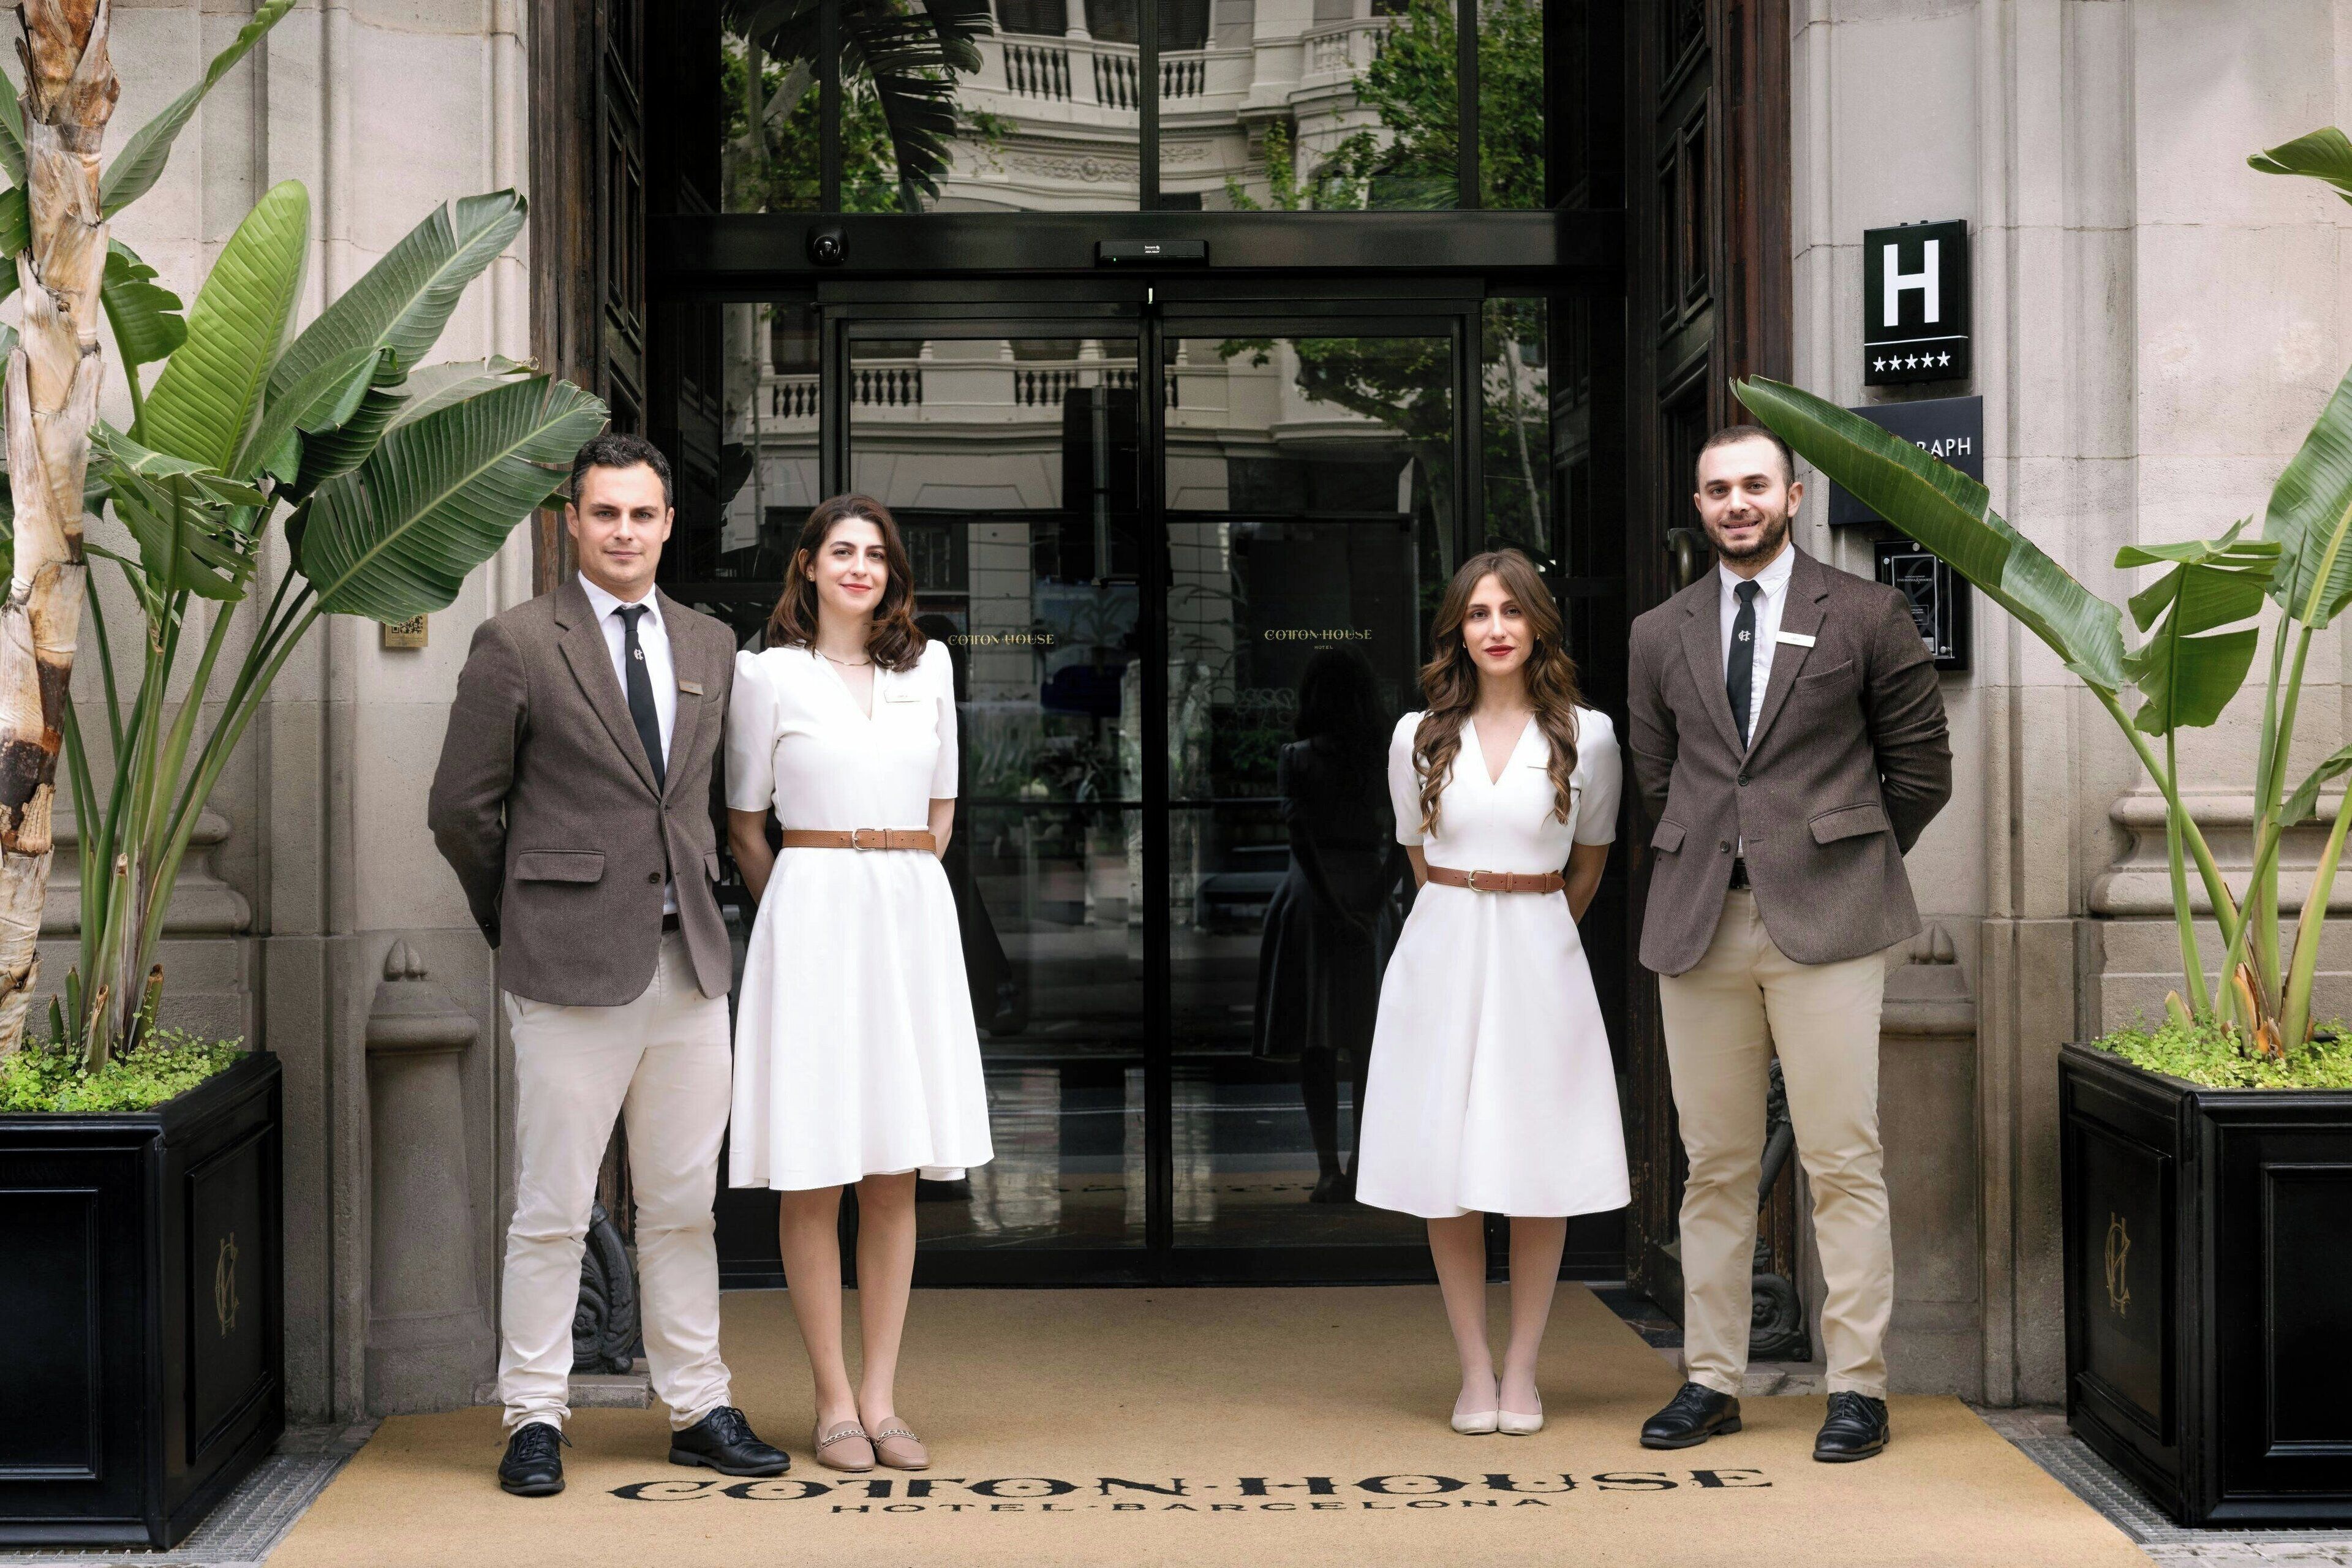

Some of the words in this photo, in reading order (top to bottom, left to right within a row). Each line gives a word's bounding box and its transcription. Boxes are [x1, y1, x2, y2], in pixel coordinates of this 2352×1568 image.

[1883, 239, 1940, 328] H
[1234, 1469, 1773, 1496] HOUSE
[831, 1503, 1076, 1513] HOTEL
[1112, 1499, 1549, 1512] BARCELONA
